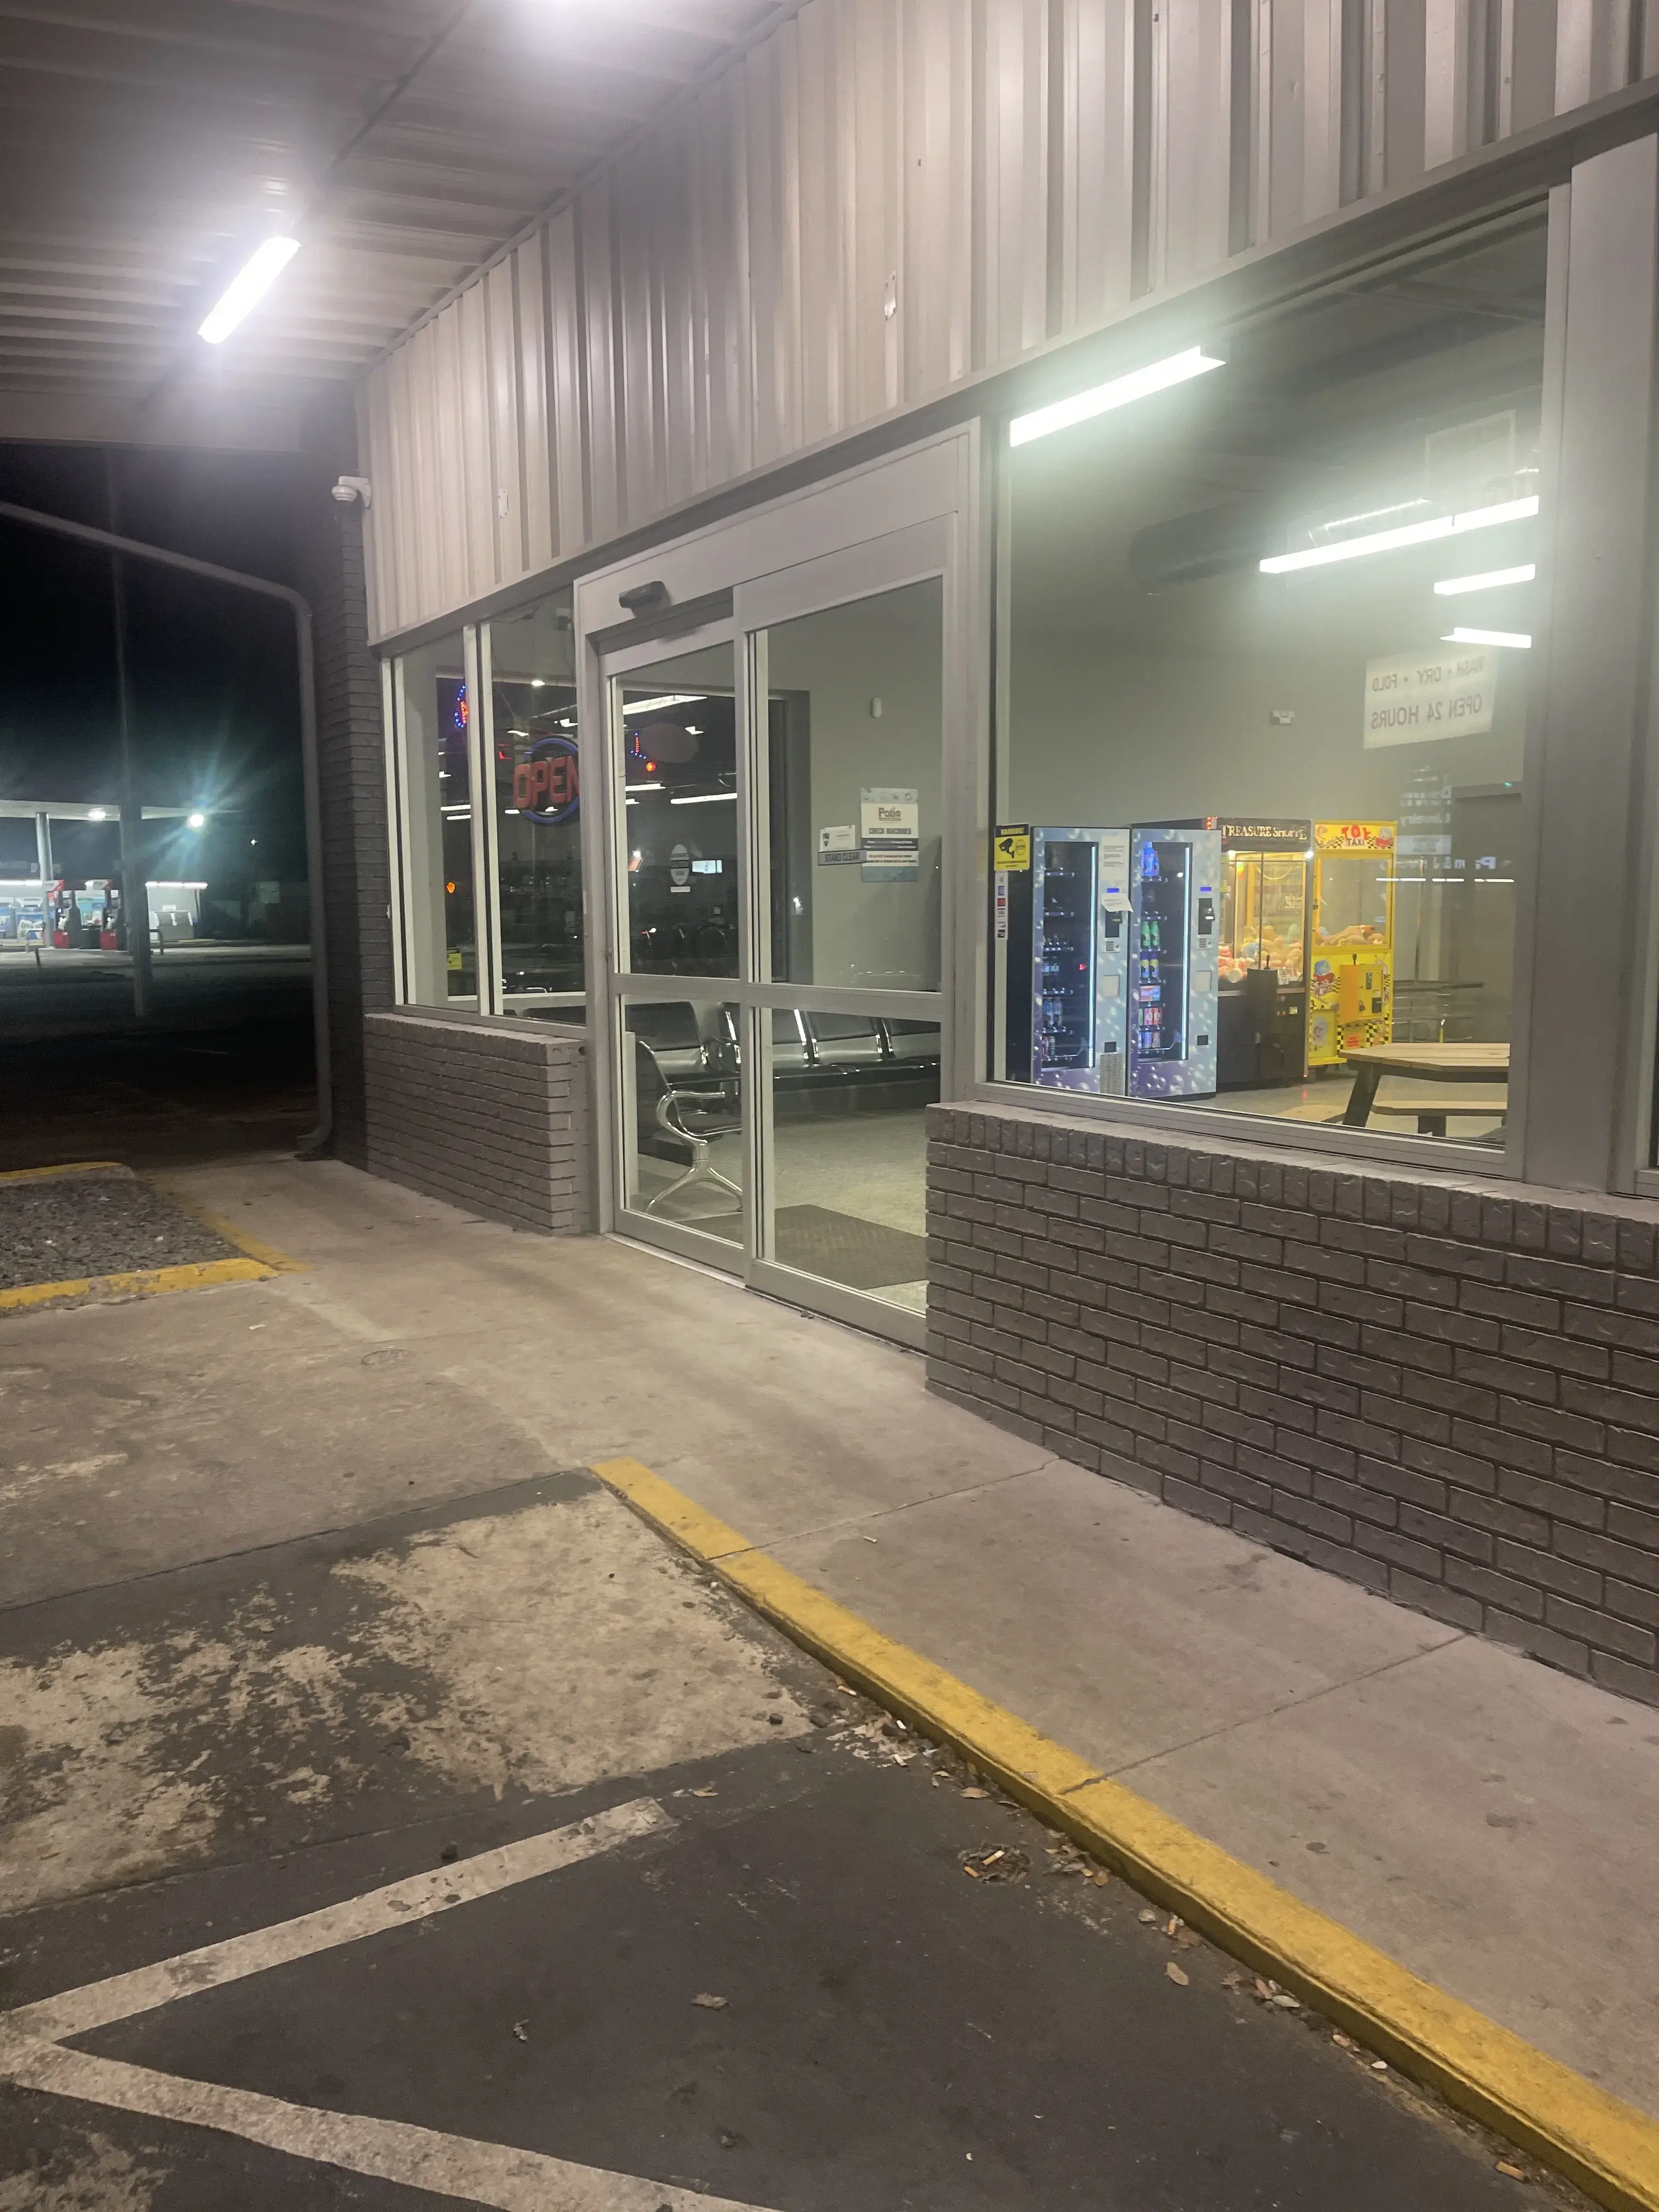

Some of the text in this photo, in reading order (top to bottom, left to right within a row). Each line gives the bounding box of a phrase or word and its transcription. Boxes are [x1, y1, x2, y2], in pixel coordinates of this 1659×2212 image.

[514, 755, 580, 809] OPEN
[1222, 825, 1272, 839] TREASURE
[1341, 825, 1371, 841] TOY
